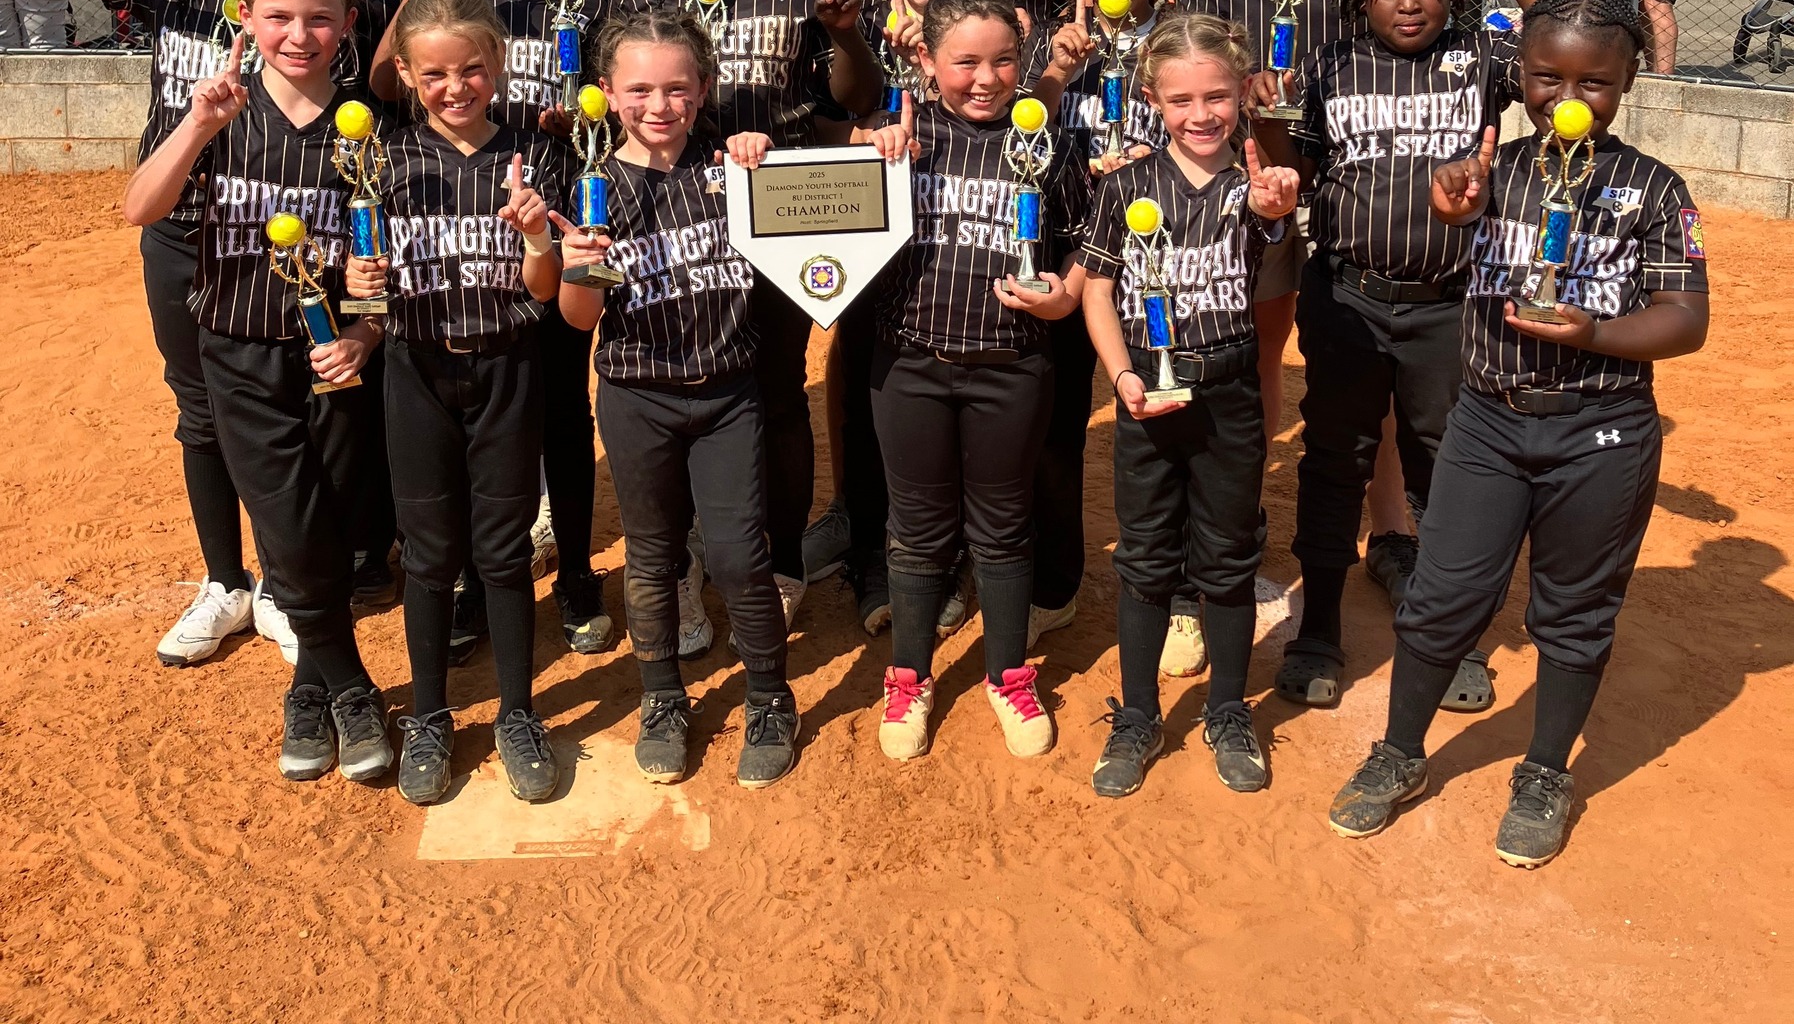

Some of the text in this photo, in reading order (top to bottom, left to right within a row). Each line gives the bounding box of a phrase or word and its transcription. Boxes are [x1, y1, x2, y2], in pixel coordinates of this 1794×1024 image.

[718, 60, 789, 88] STARS
[509, 78, 564, 112] STA
[1325, 83, 1483, 145] SPRINGFIELD
[1338, 133, 1387, 168] ALL
[766, 184, 803, 192] DIAMOND
[834, 181, 869, 189] SOFTBALL
[808, 171, 826, 179] 2025
[775, 202, 861, 217] CHAMPION
[804, 193, 837, 201] DISTRICT
[1608, 189, 1635, 203] SPT
[909, 218, 1023, 258] LL STAR
[399, 263, 452, 299] ALL
[1175, 276, 1248, 320] STARS
[1520, 272, 1622, 318] SARS
